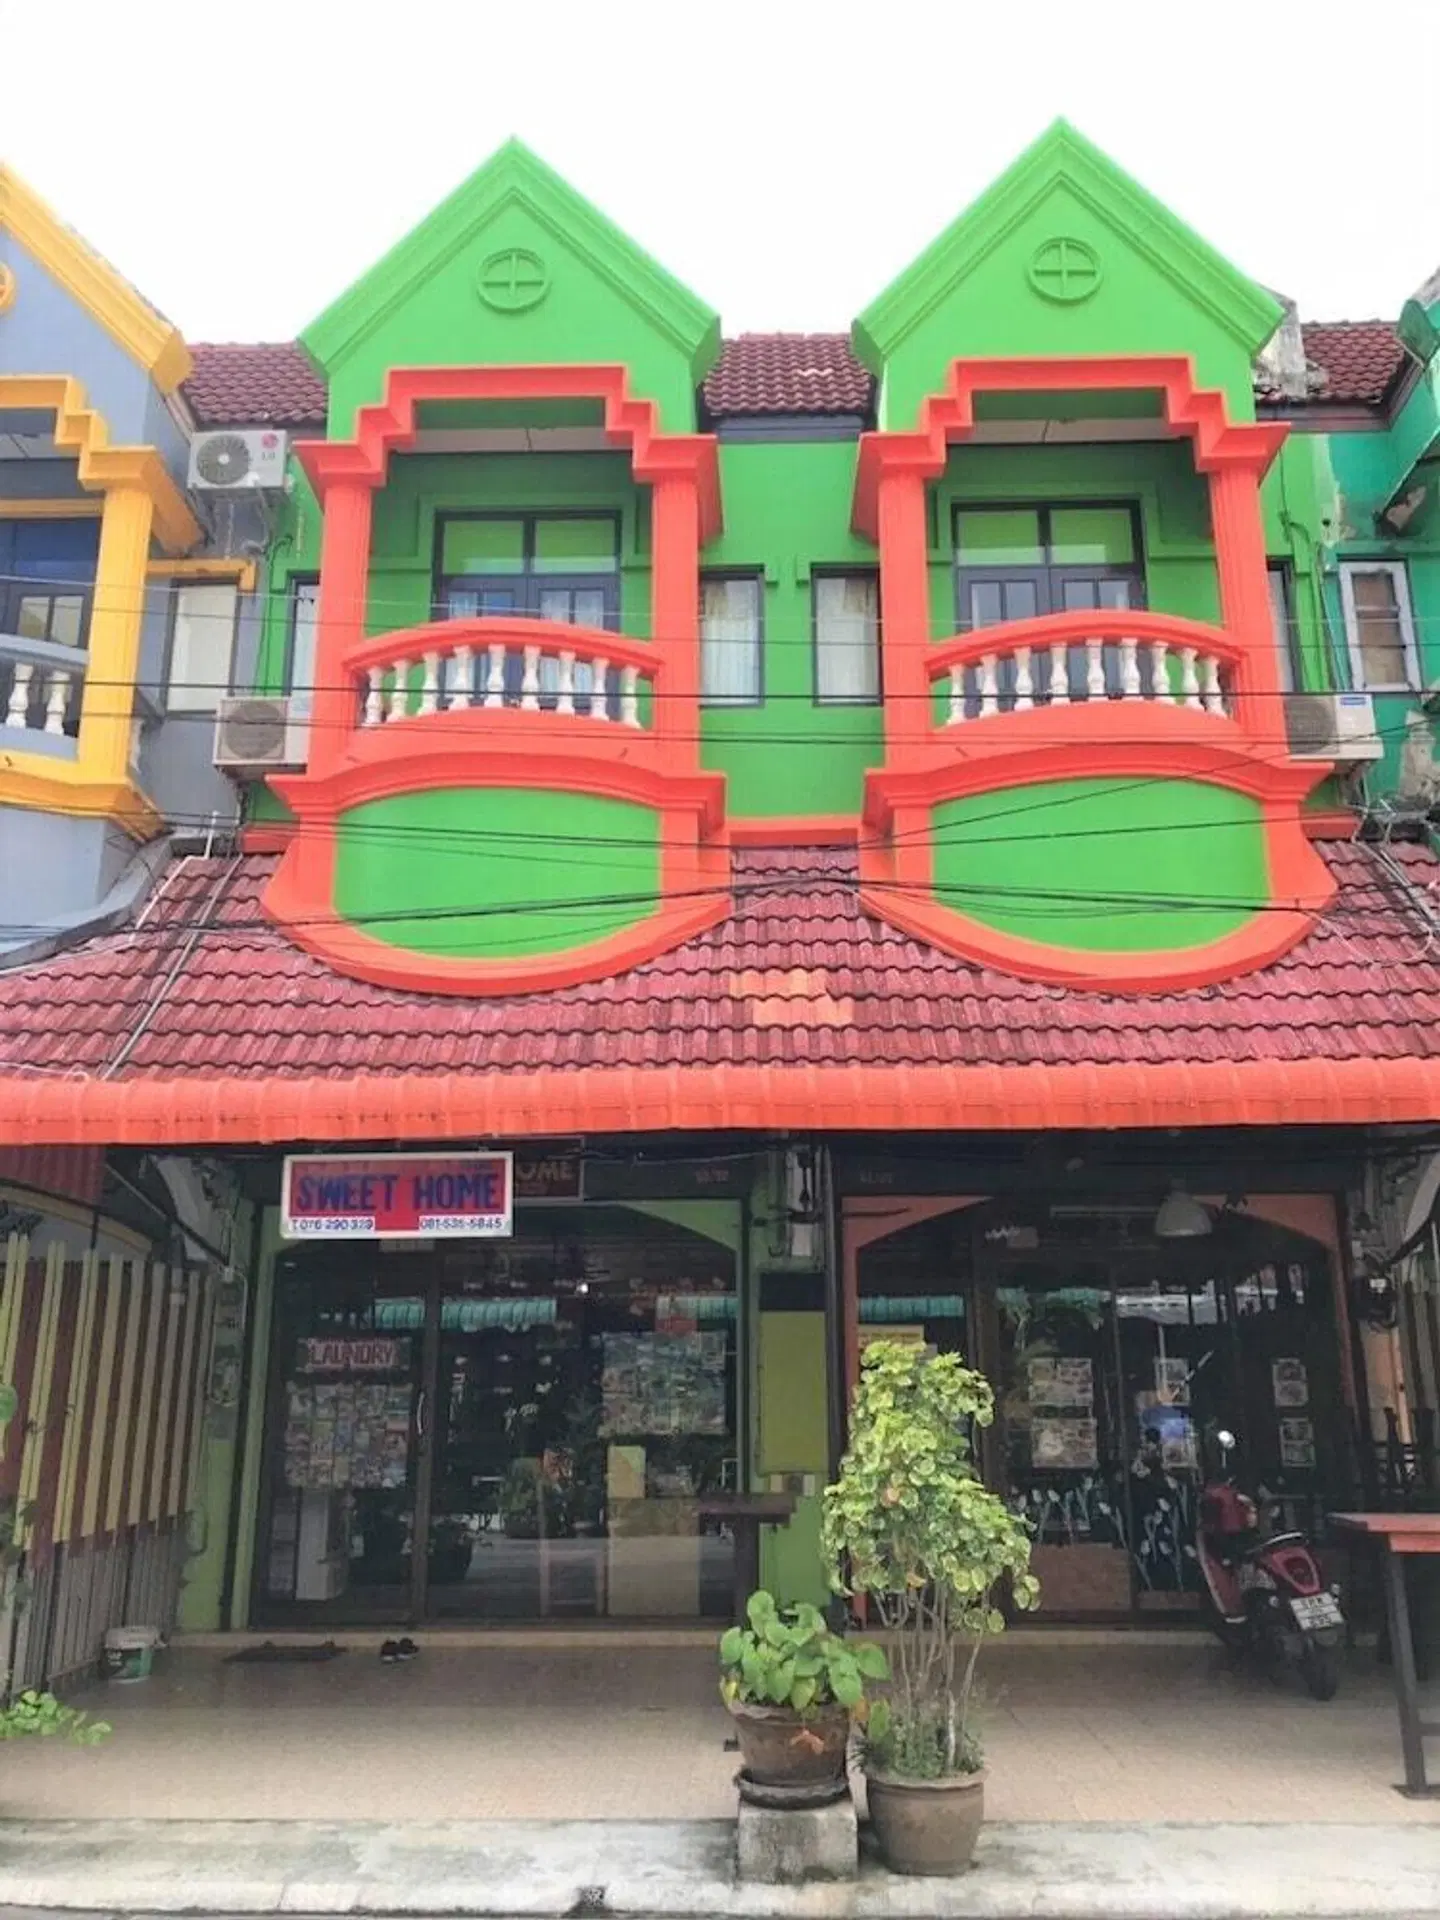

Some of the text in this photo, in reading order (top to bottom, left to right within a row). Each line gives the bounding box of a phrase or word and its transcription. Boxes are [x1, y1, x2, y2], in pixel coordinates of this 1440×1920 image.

[299, 1172, 499, 1213] SWEET HOME
[309, 1342, 393, 1366] LAUNDRY
